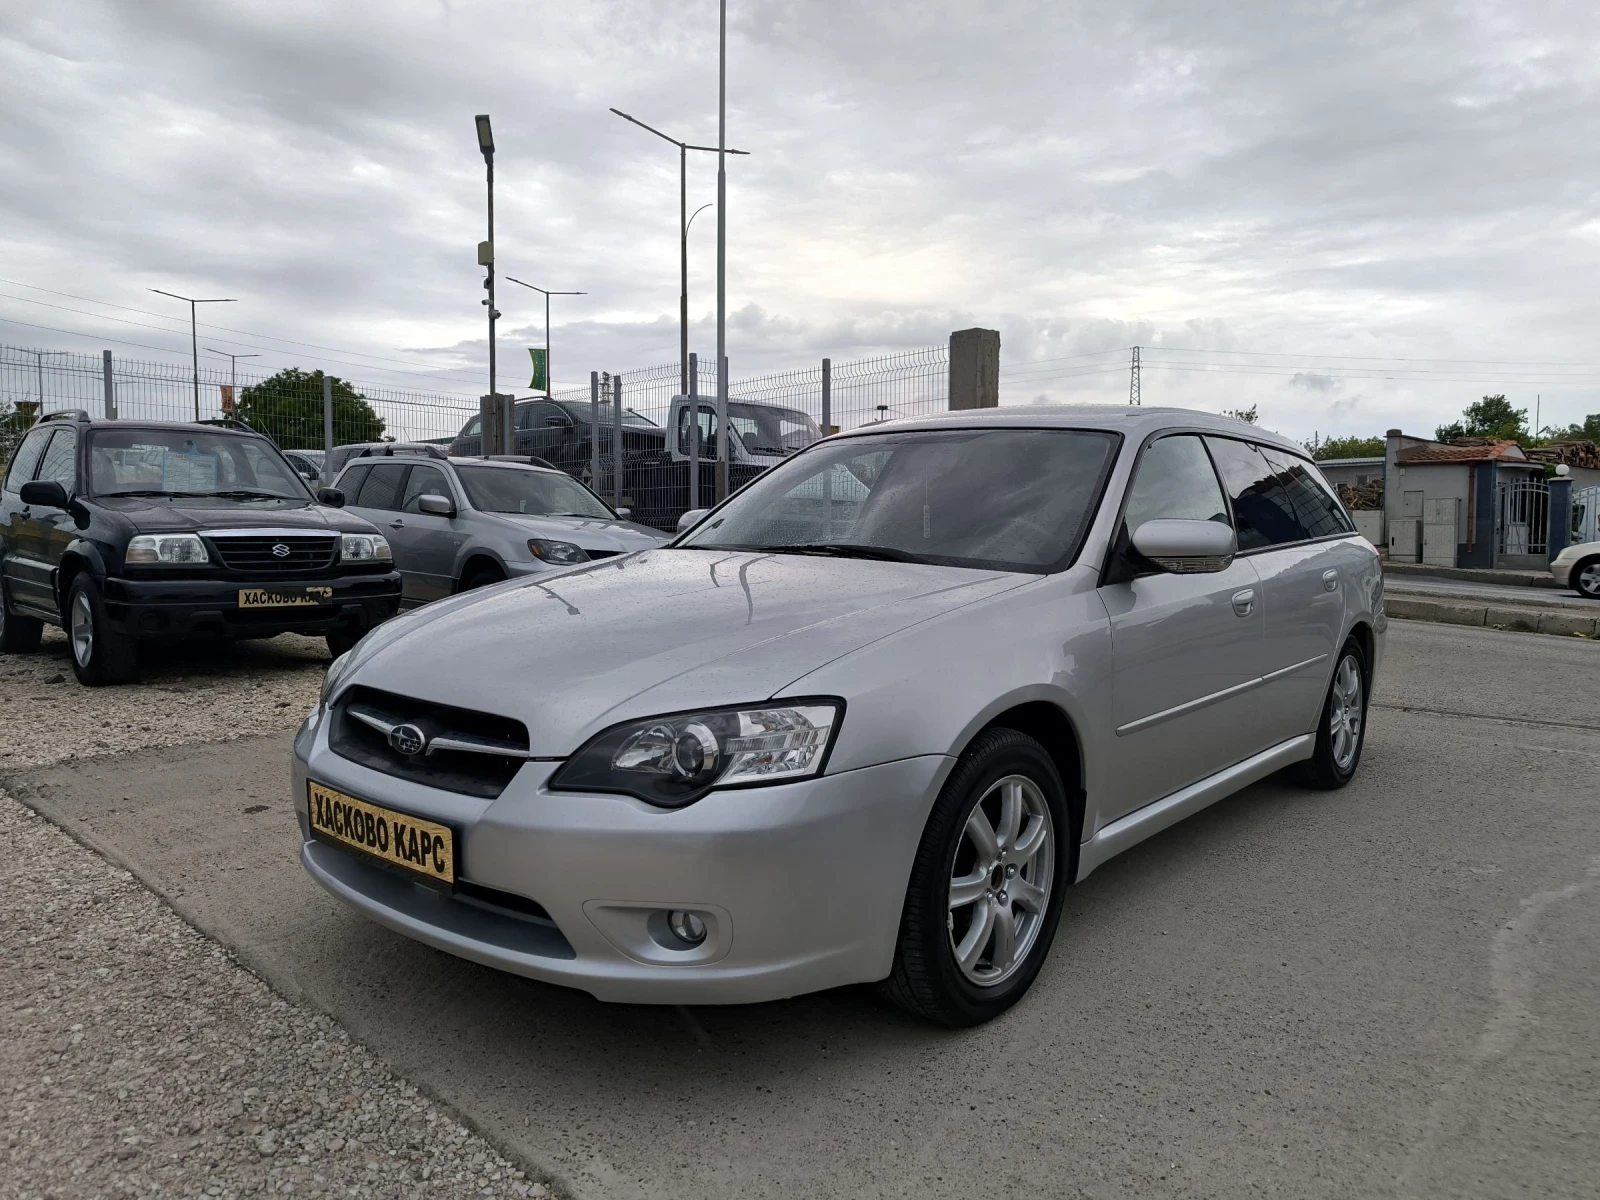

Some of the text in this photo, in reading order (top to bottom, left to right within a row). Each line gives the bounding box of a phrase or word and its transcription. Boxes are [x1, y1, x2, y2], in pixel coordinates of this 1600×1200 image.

[243, 591, 298, 605] ХАСКОВО
[314, 792, 446, 874] ХАСКОВО КАРС
